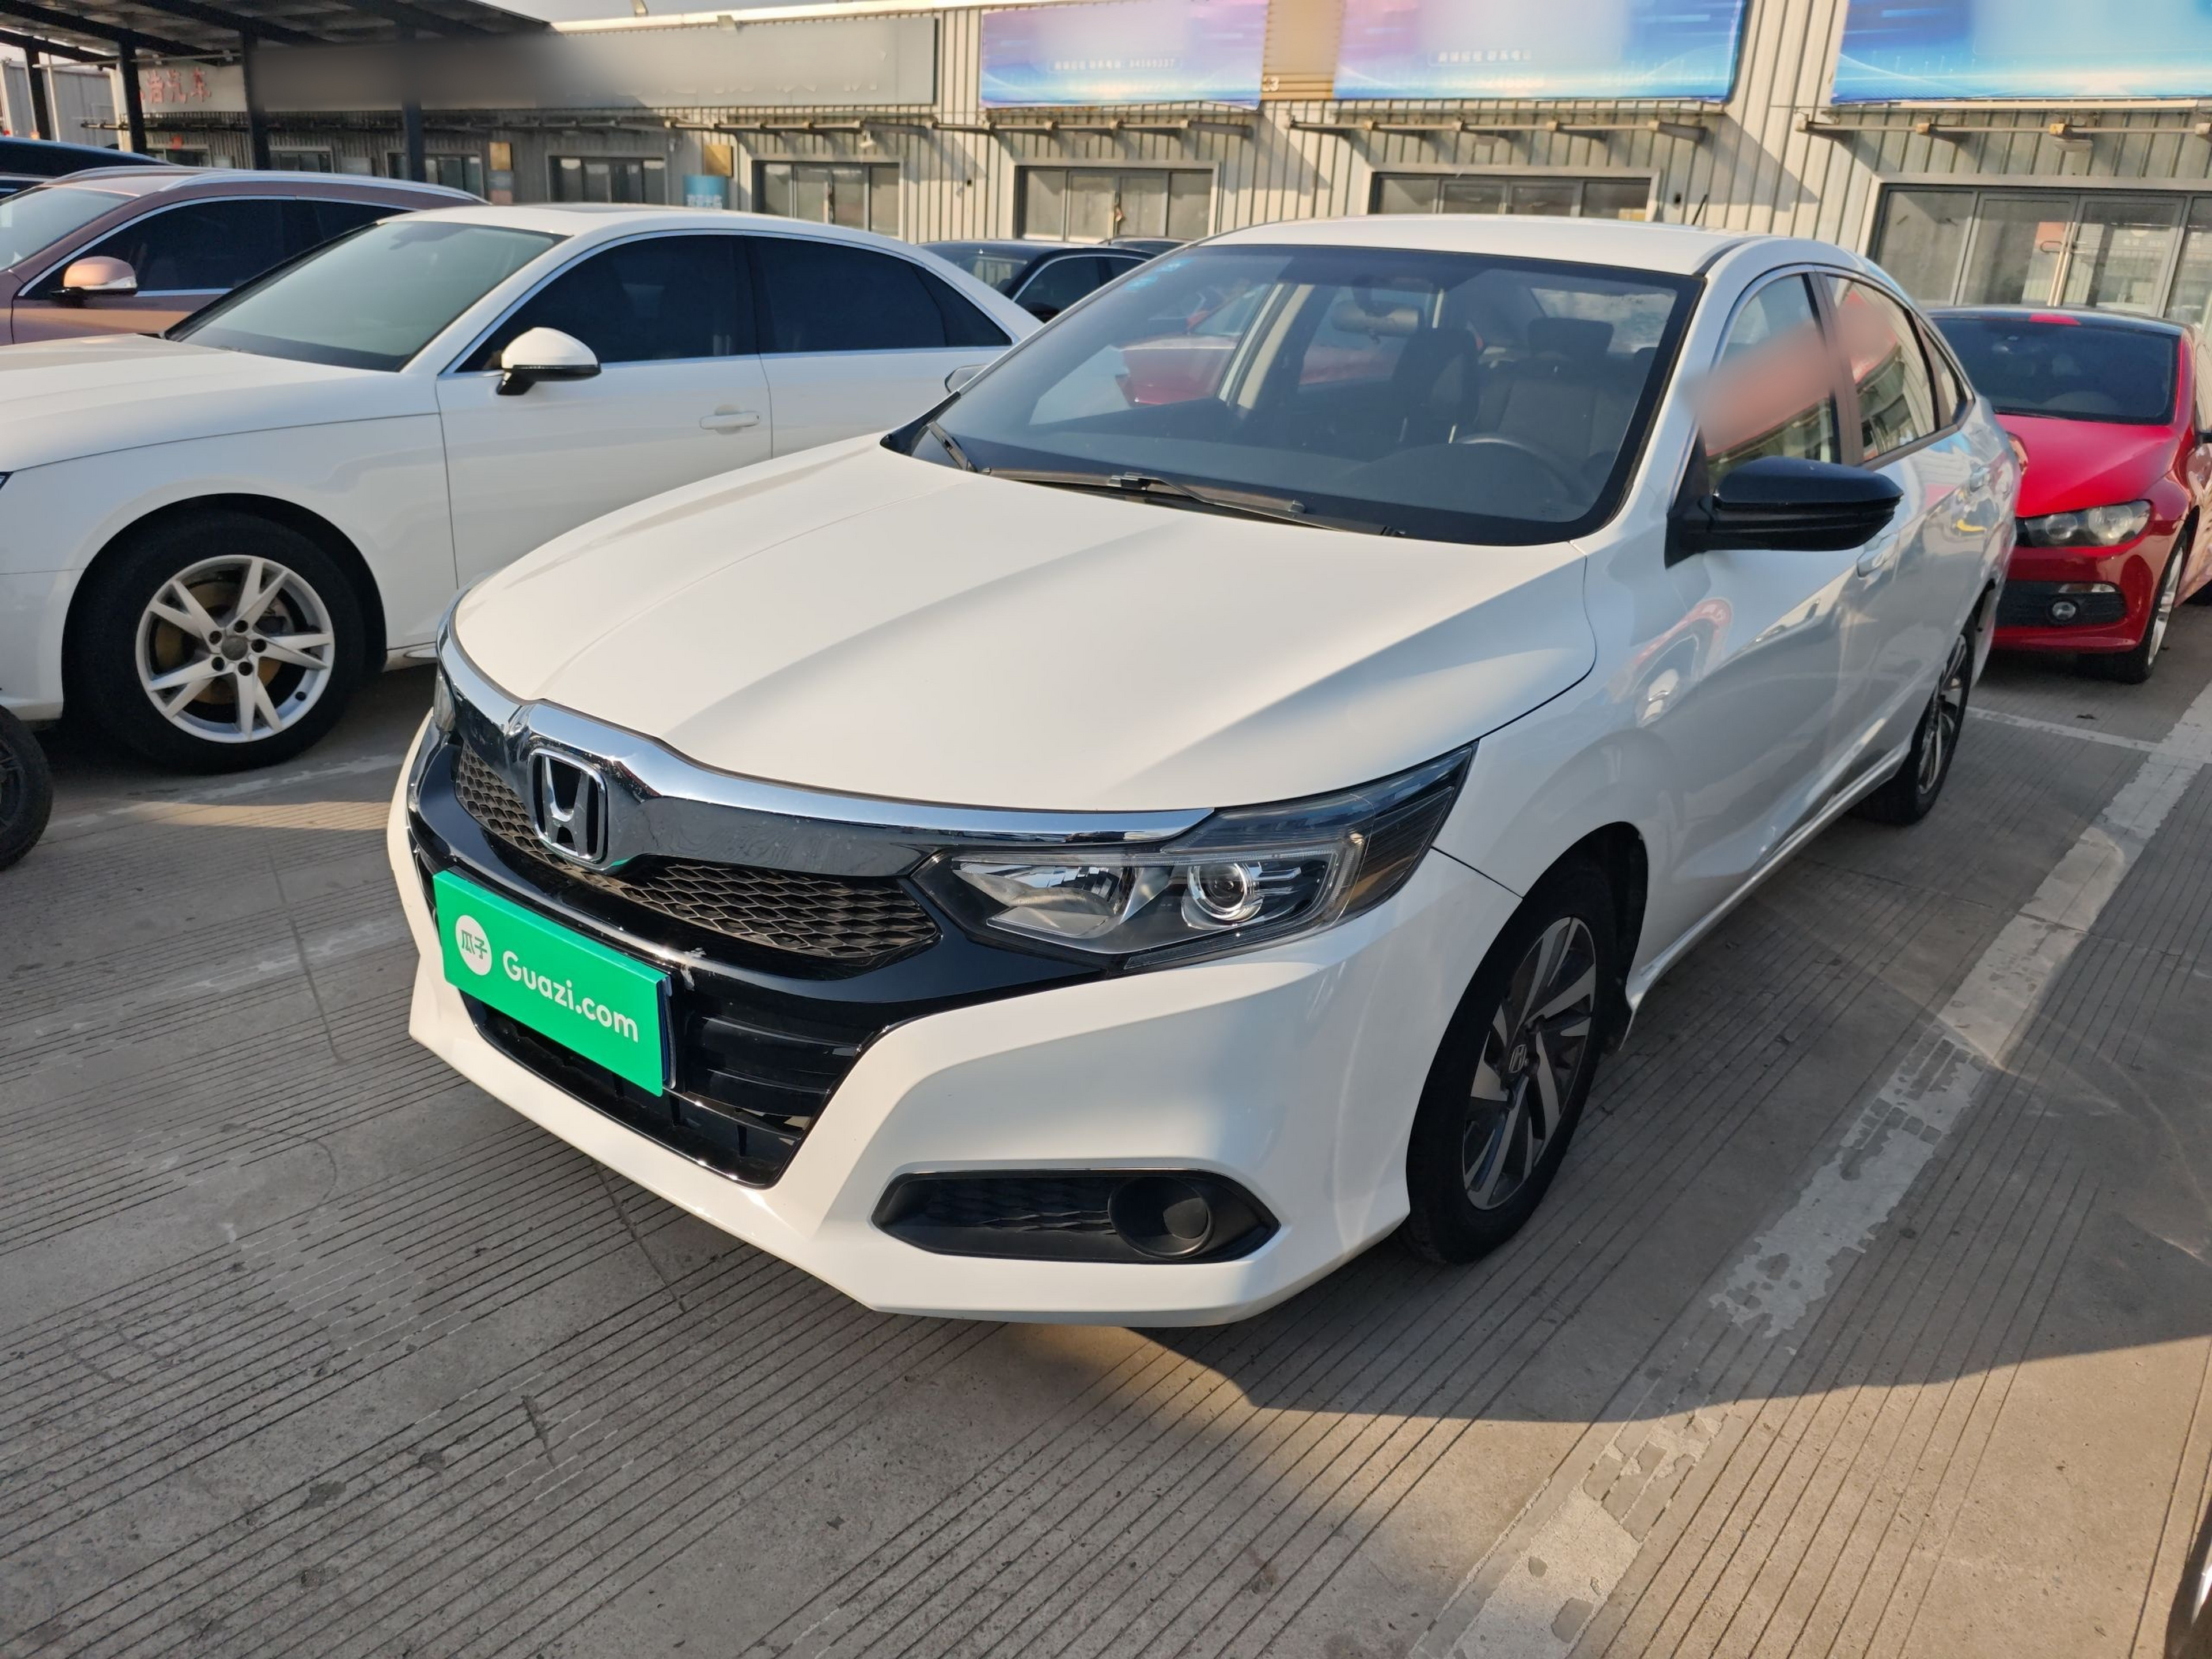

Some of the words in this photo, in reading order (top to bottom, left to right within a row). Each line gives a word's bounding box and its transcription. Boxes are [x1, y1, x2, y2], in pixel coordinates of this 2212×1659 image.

[140, 67, 212, 104] 浩汽车
[461, 929, 488, 960] 瓜子
[502, 950, 639, 1043] Guazi.com
